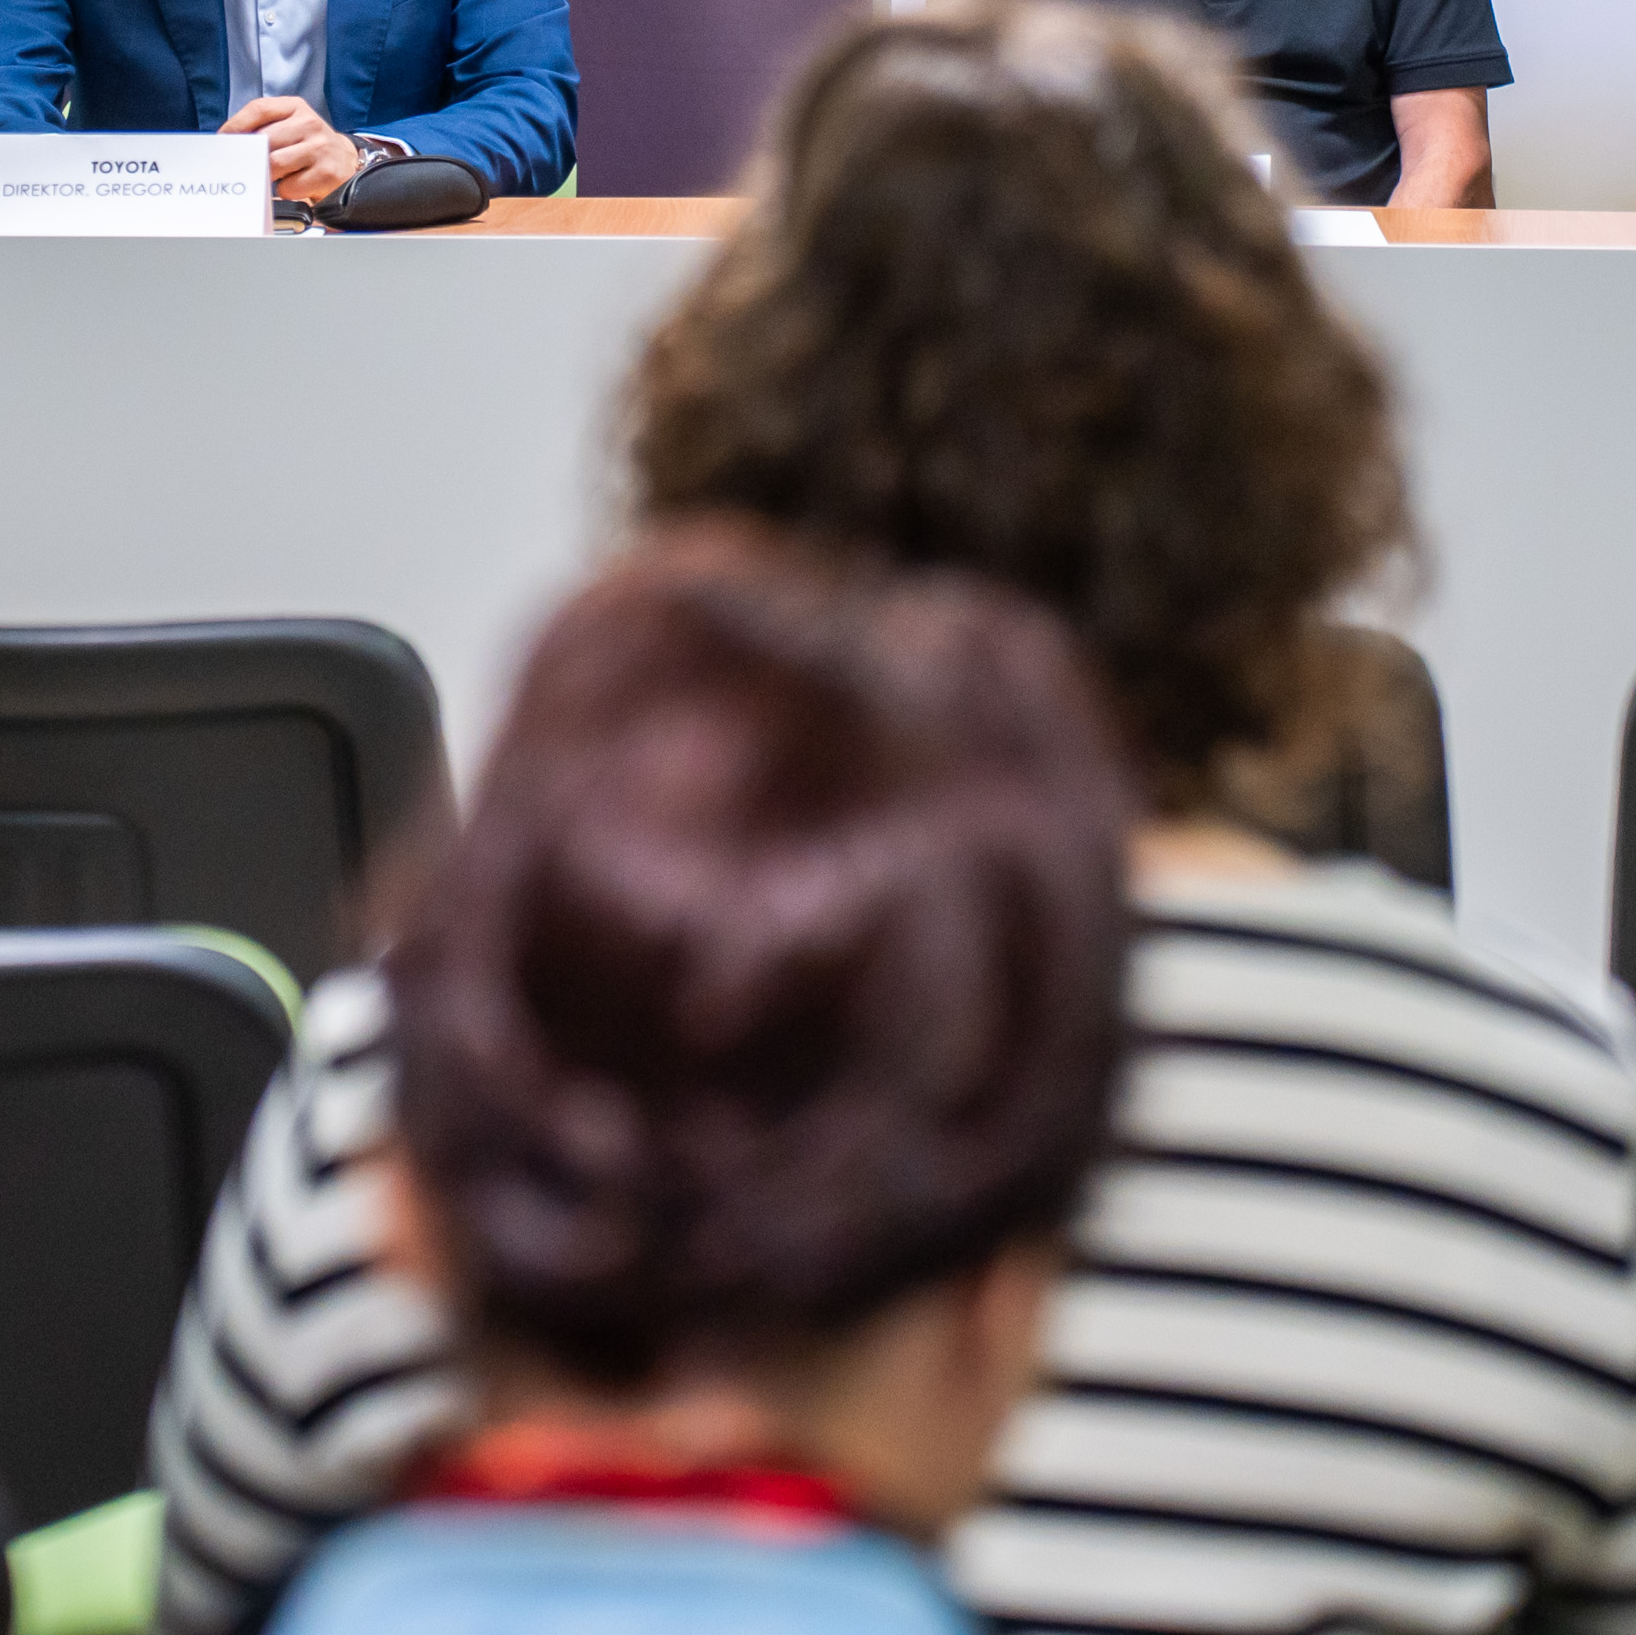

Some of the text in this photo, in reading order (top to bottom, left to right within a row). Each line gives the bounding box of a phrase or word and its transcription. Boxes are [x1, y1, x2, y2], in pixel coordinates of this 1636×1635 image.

[91, 161, 160, 174] TOYOTA
[95, 183, 173, 196] GREGOR
[179, 182, 246, 196] MAUKO
